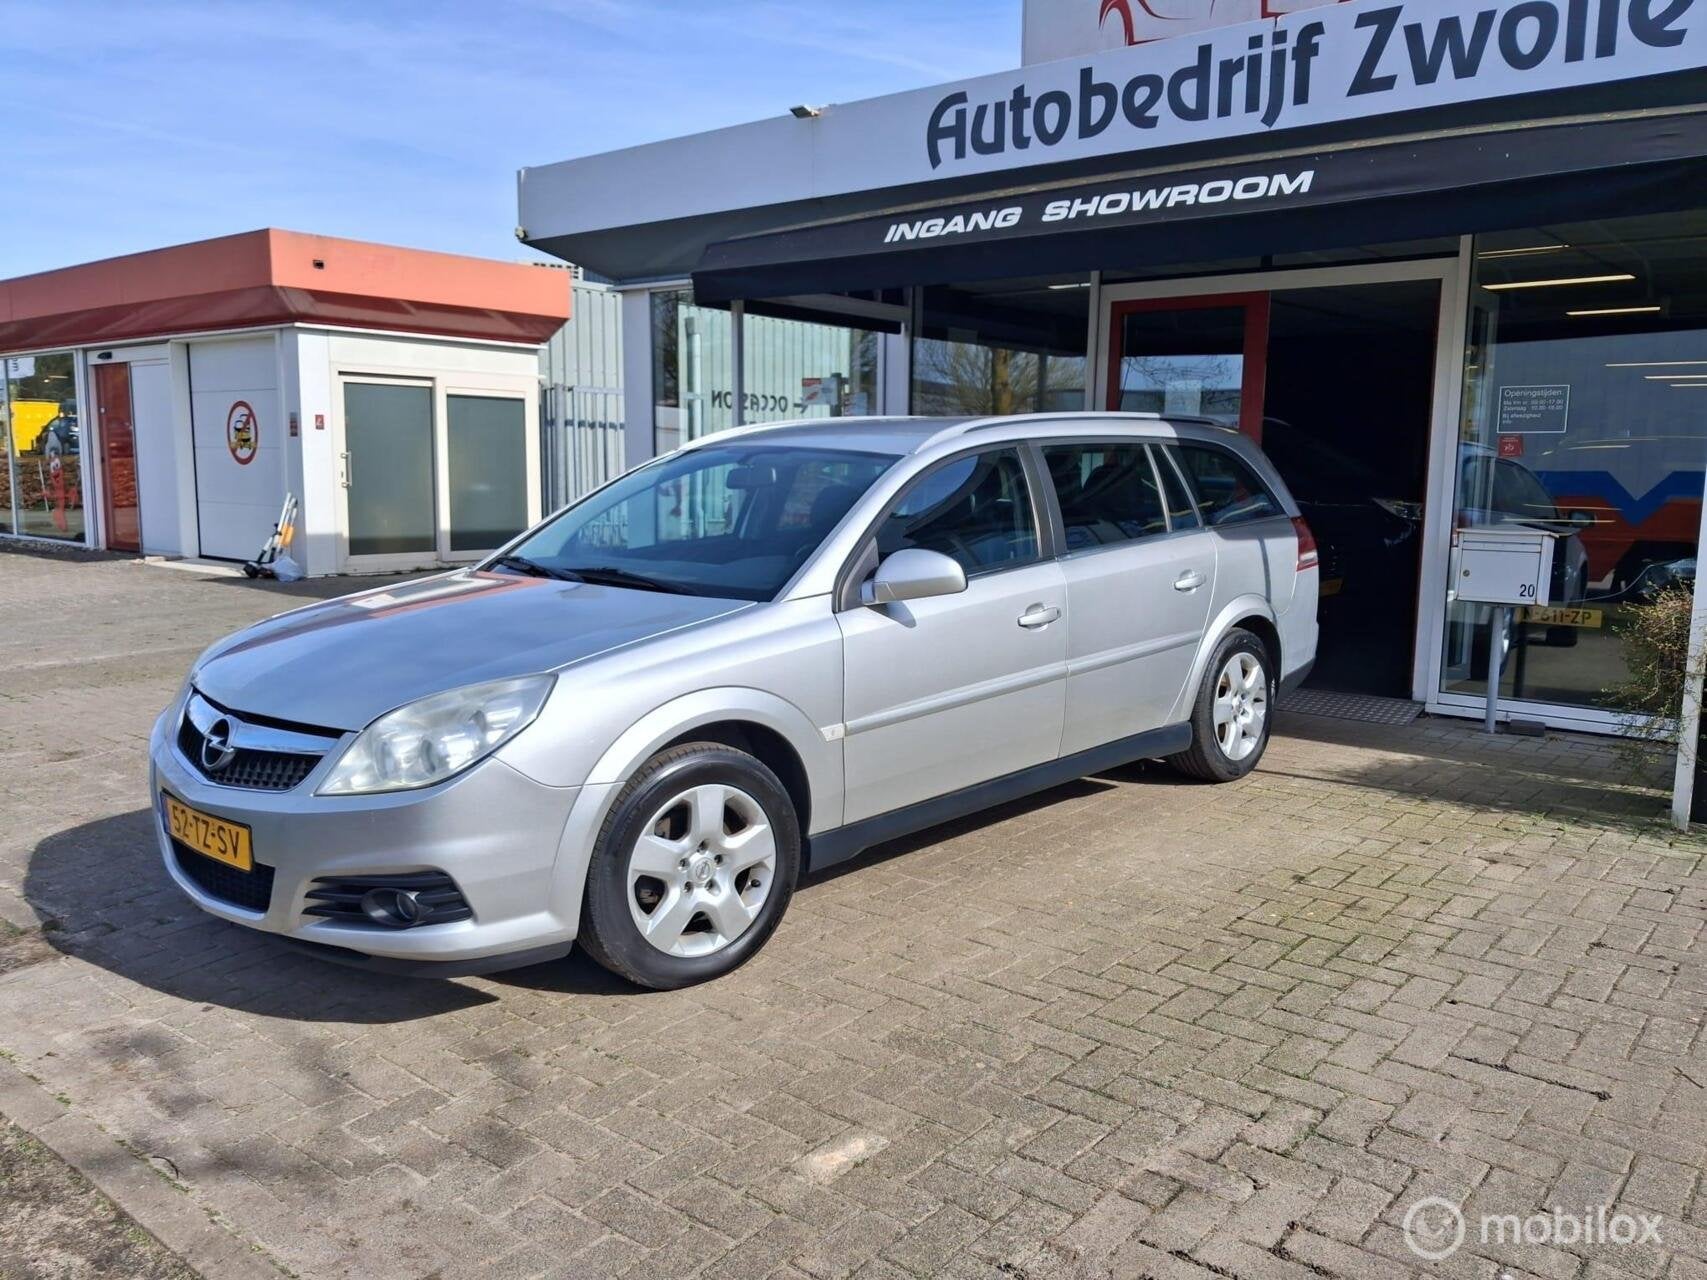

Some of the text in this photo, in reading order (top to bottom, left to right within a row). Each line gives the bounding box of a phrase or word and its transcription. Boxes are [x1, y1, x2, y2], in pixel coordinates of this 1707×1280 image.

[927, 0, 1695, 169] Autobedrijf Zwolle
[883, 170, 1315, 243] INGANG SHOWROOM
[1504, 388, 1562, 398] Openingstijden
[1519, 584, 1535, 598] 20
[172, 805, 239, 859] 52-TZ-SV
